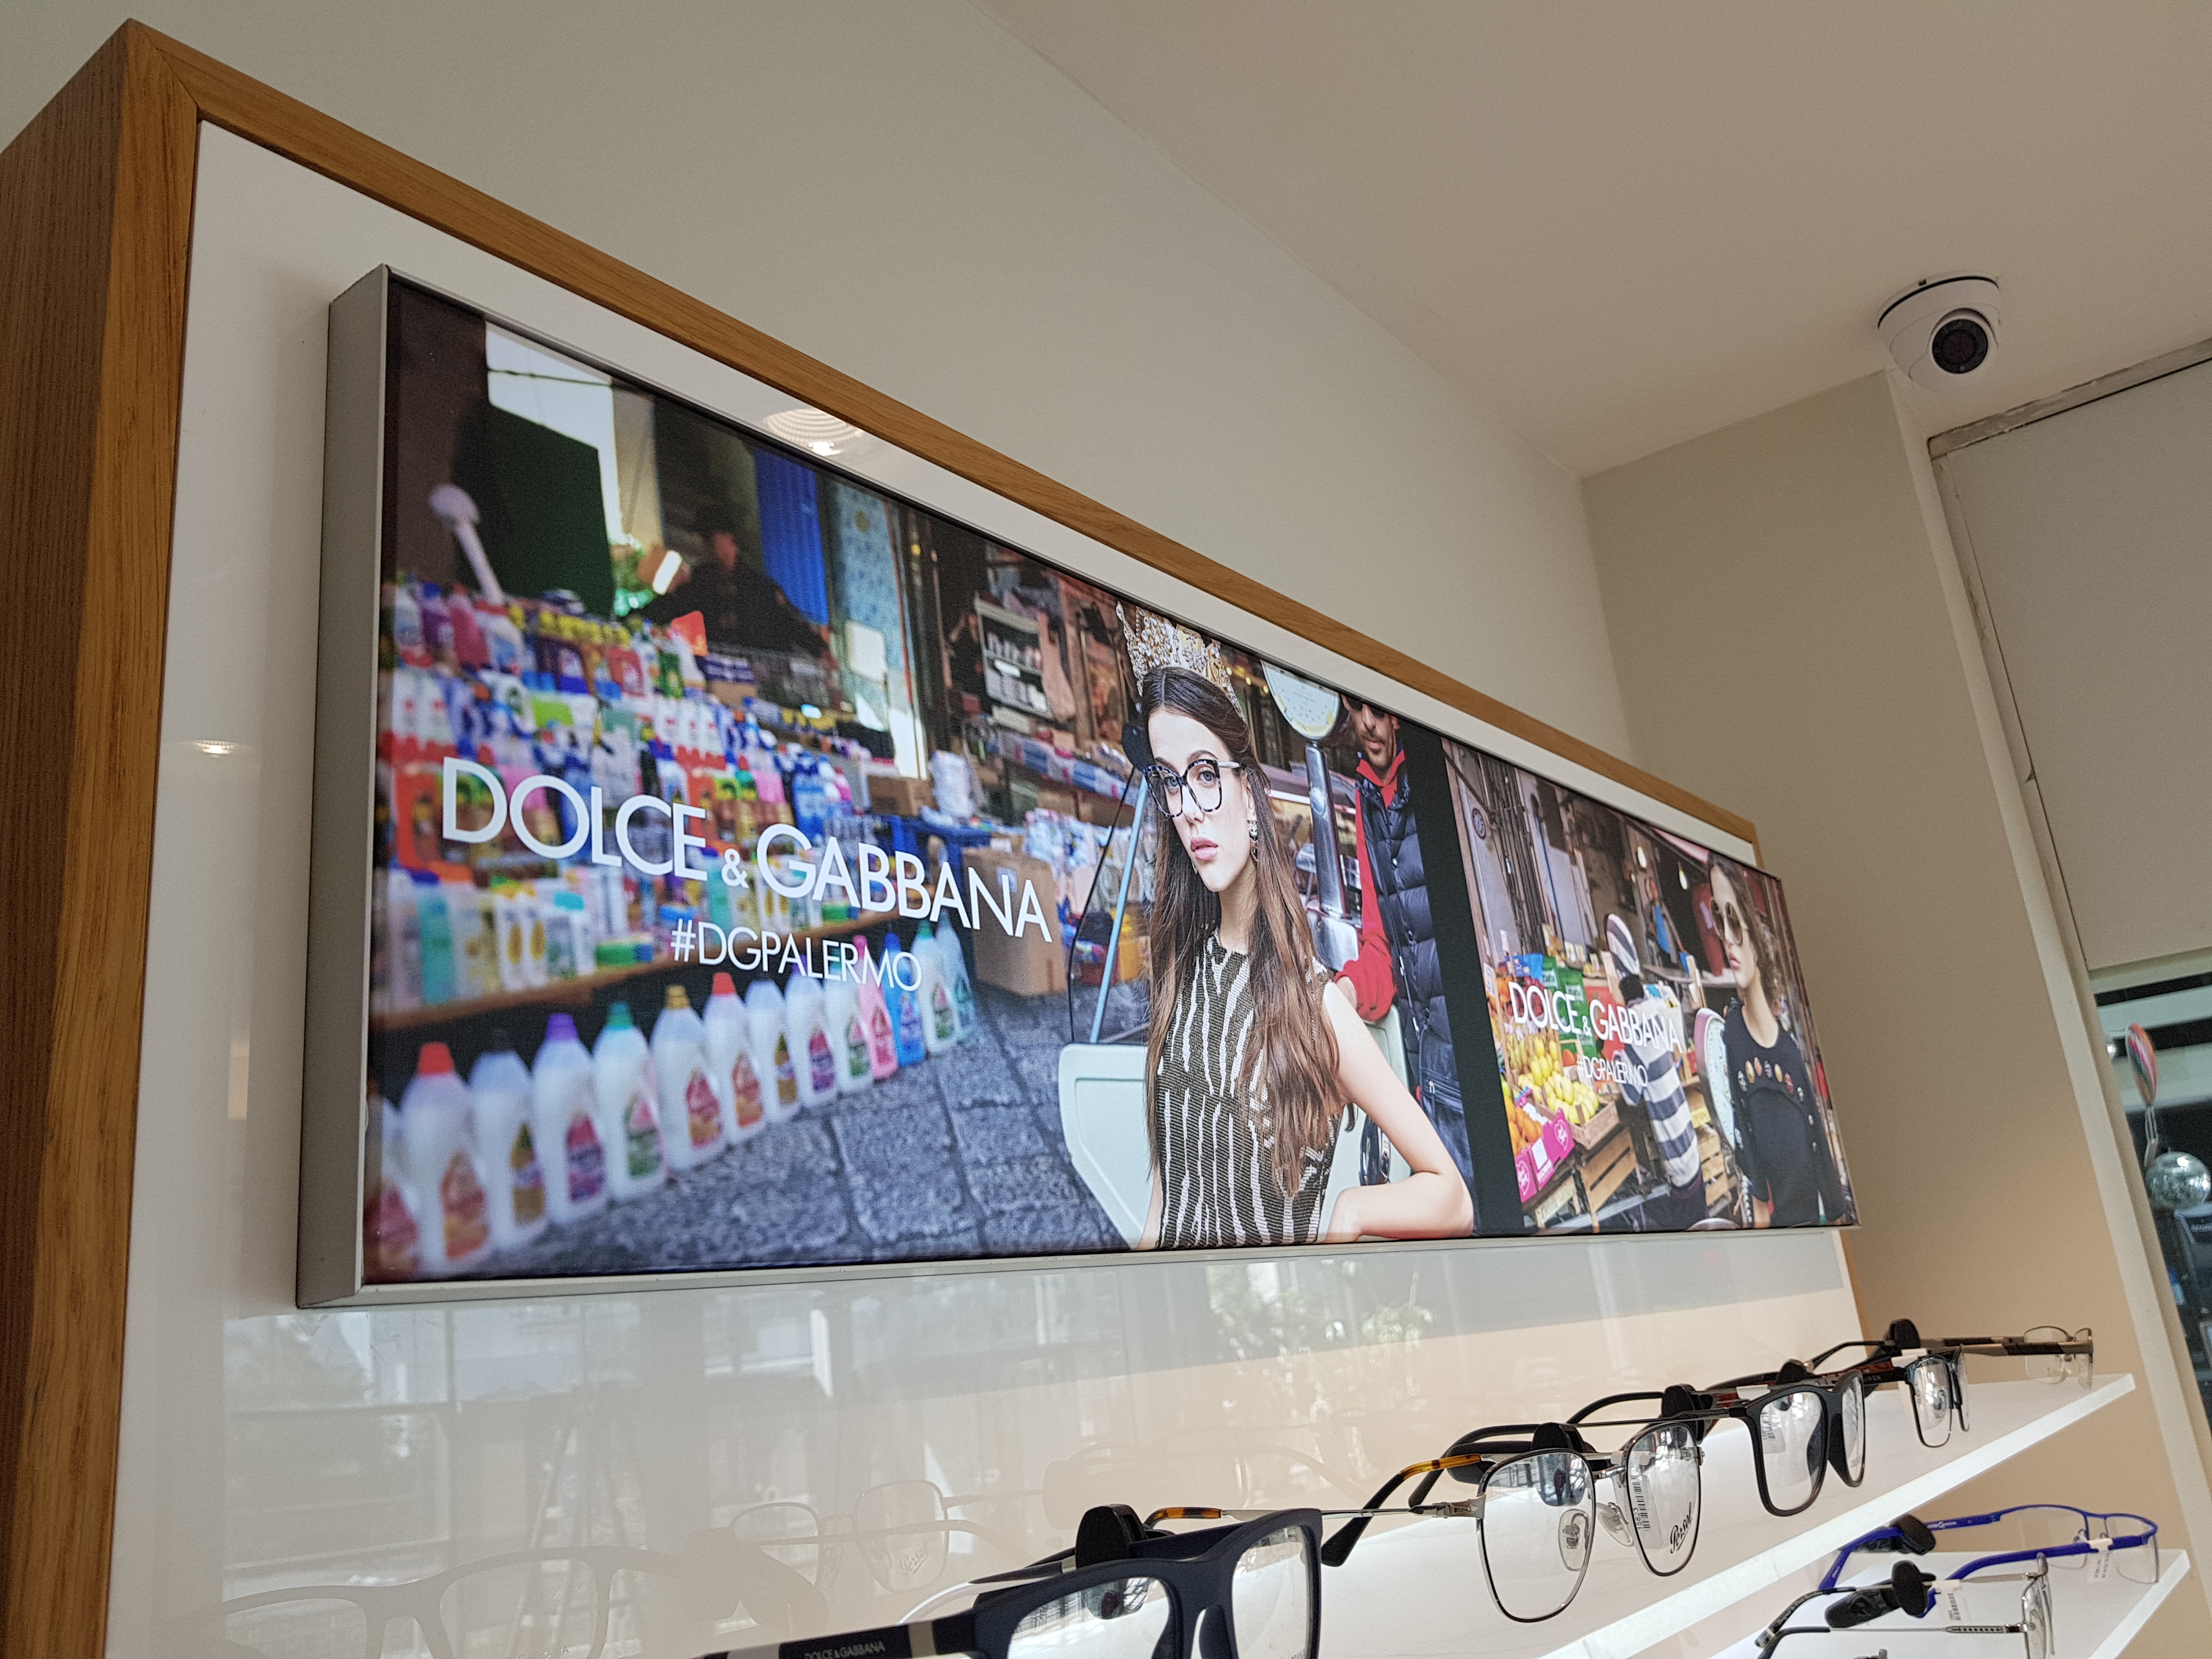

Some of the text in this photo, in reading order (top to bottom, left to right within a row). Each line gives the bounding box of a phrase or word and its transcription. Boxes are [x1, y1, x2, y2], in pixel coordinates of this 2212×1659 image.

[442, 756, 1053, 943] DOLCE & GABBANA
[670, 918, 922, 991] #DGPALERMO
[1508, 981, 1581, 1034] DOLCE
[1582, 1015, 1592, 1036] &
[1589, 998, 1684, 1054] GABBANA
[1577, 1054, 1648, 1087] #DGPALERMO
[1669, 1502, 1693, 1554] Persol
[840, 1640, 886, 1657] GABBANA
